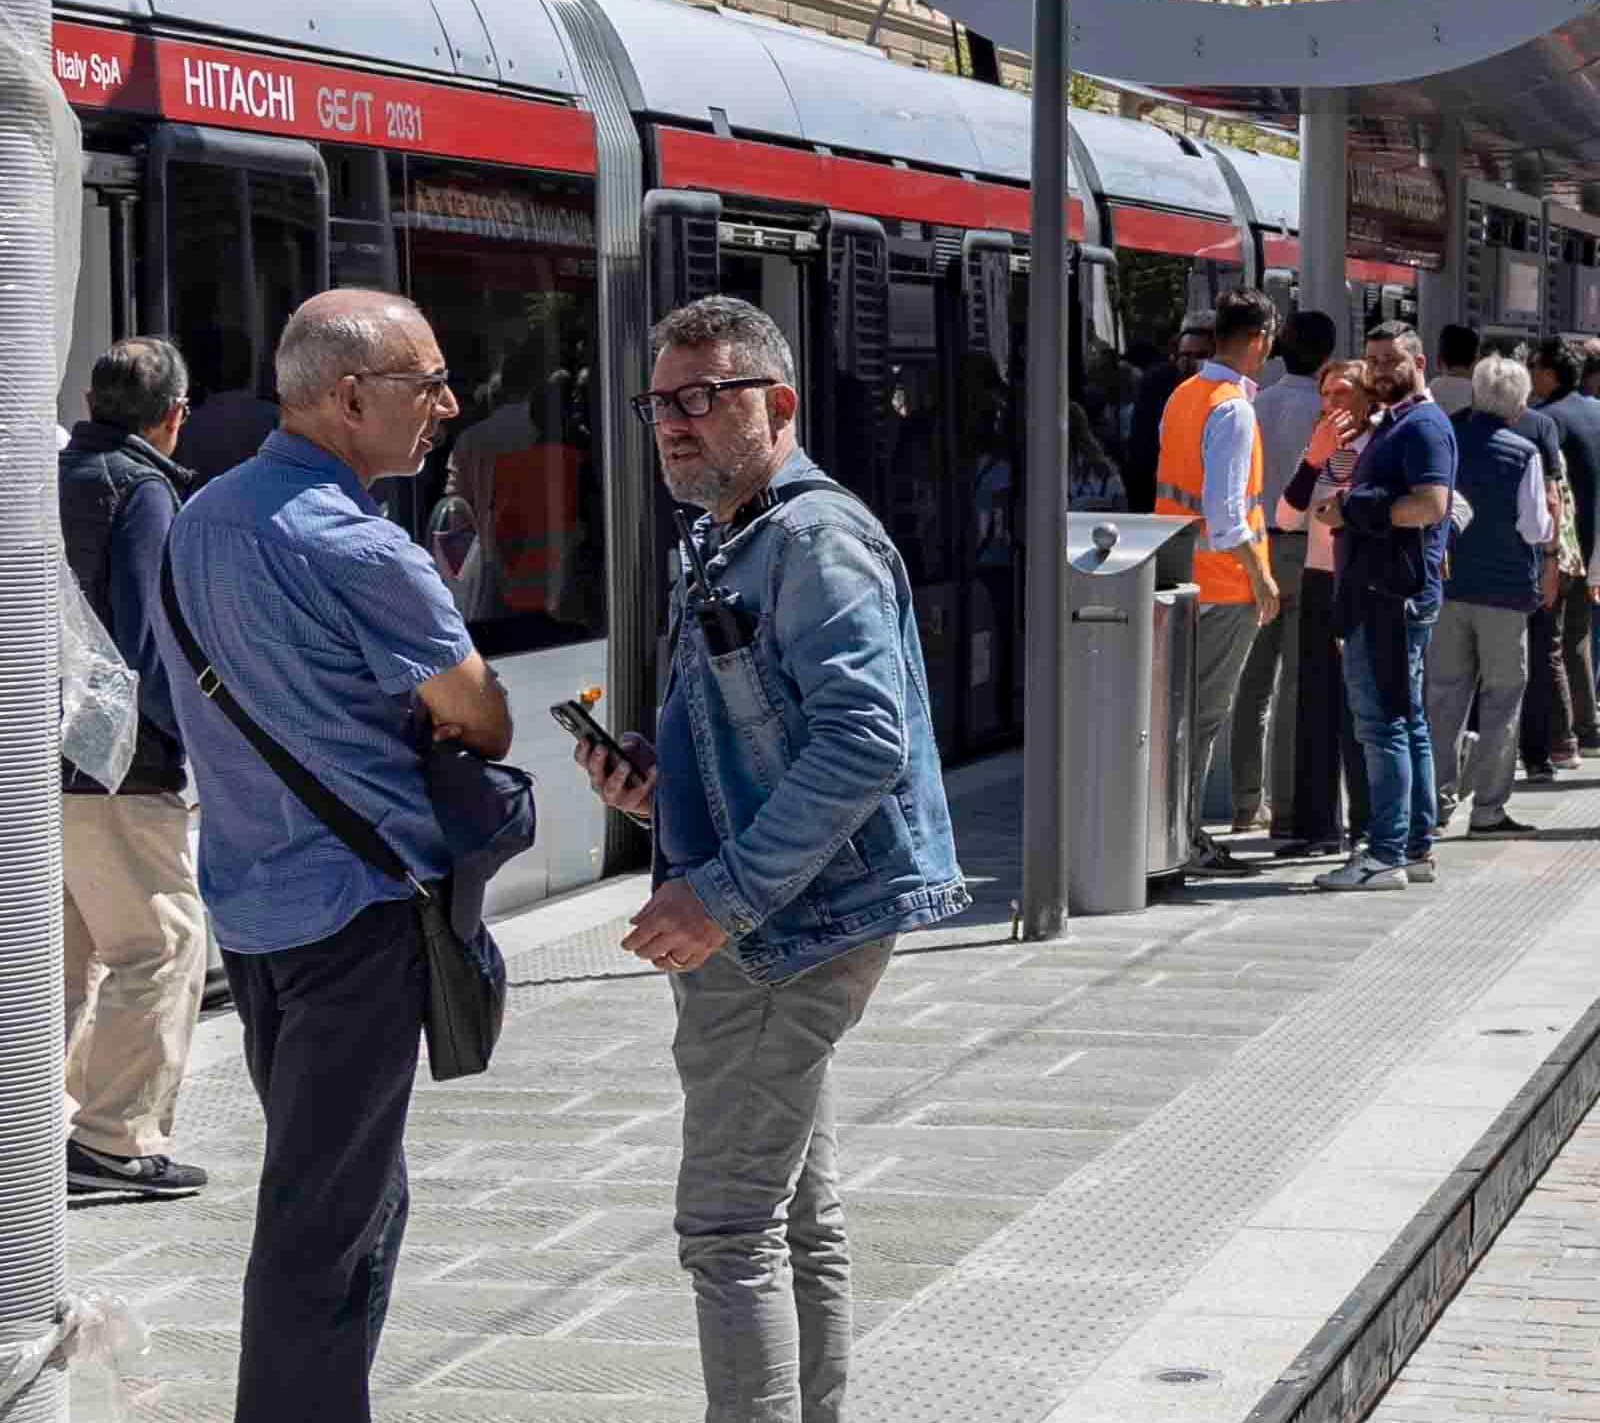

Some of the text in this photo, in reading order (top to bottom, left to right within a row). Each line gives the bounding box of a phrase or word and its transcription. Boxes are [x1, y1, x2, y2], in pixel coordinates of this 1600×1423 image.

[55, 49, 124, 91] Italy SpA
[183, 57, 424, 142] HITACHI GEST 2031
